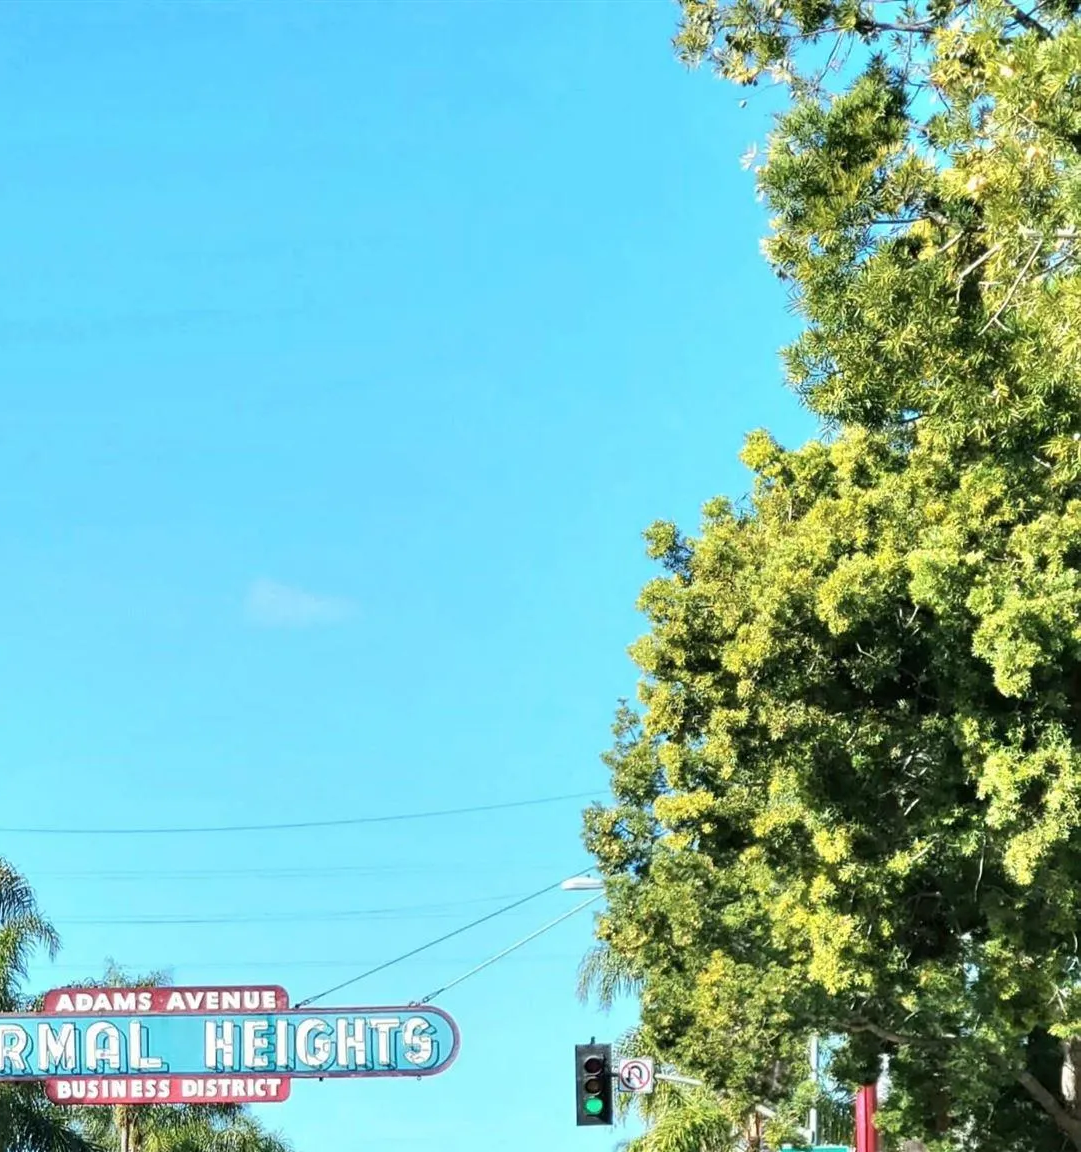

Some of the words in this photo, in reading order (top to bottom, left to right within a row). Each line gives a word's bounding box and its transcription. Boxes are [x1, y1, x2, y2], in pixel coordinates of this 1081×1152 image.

[56, 993, 152, 1012] ADAMS
[166, 990, 277, 1011] AVENUE
[204, 1016, 436, 1070] HEIGHTS
[57, 1080, 170, 1099] BUSINESS
[181, 1078, 281, 1098] DISTRICT
